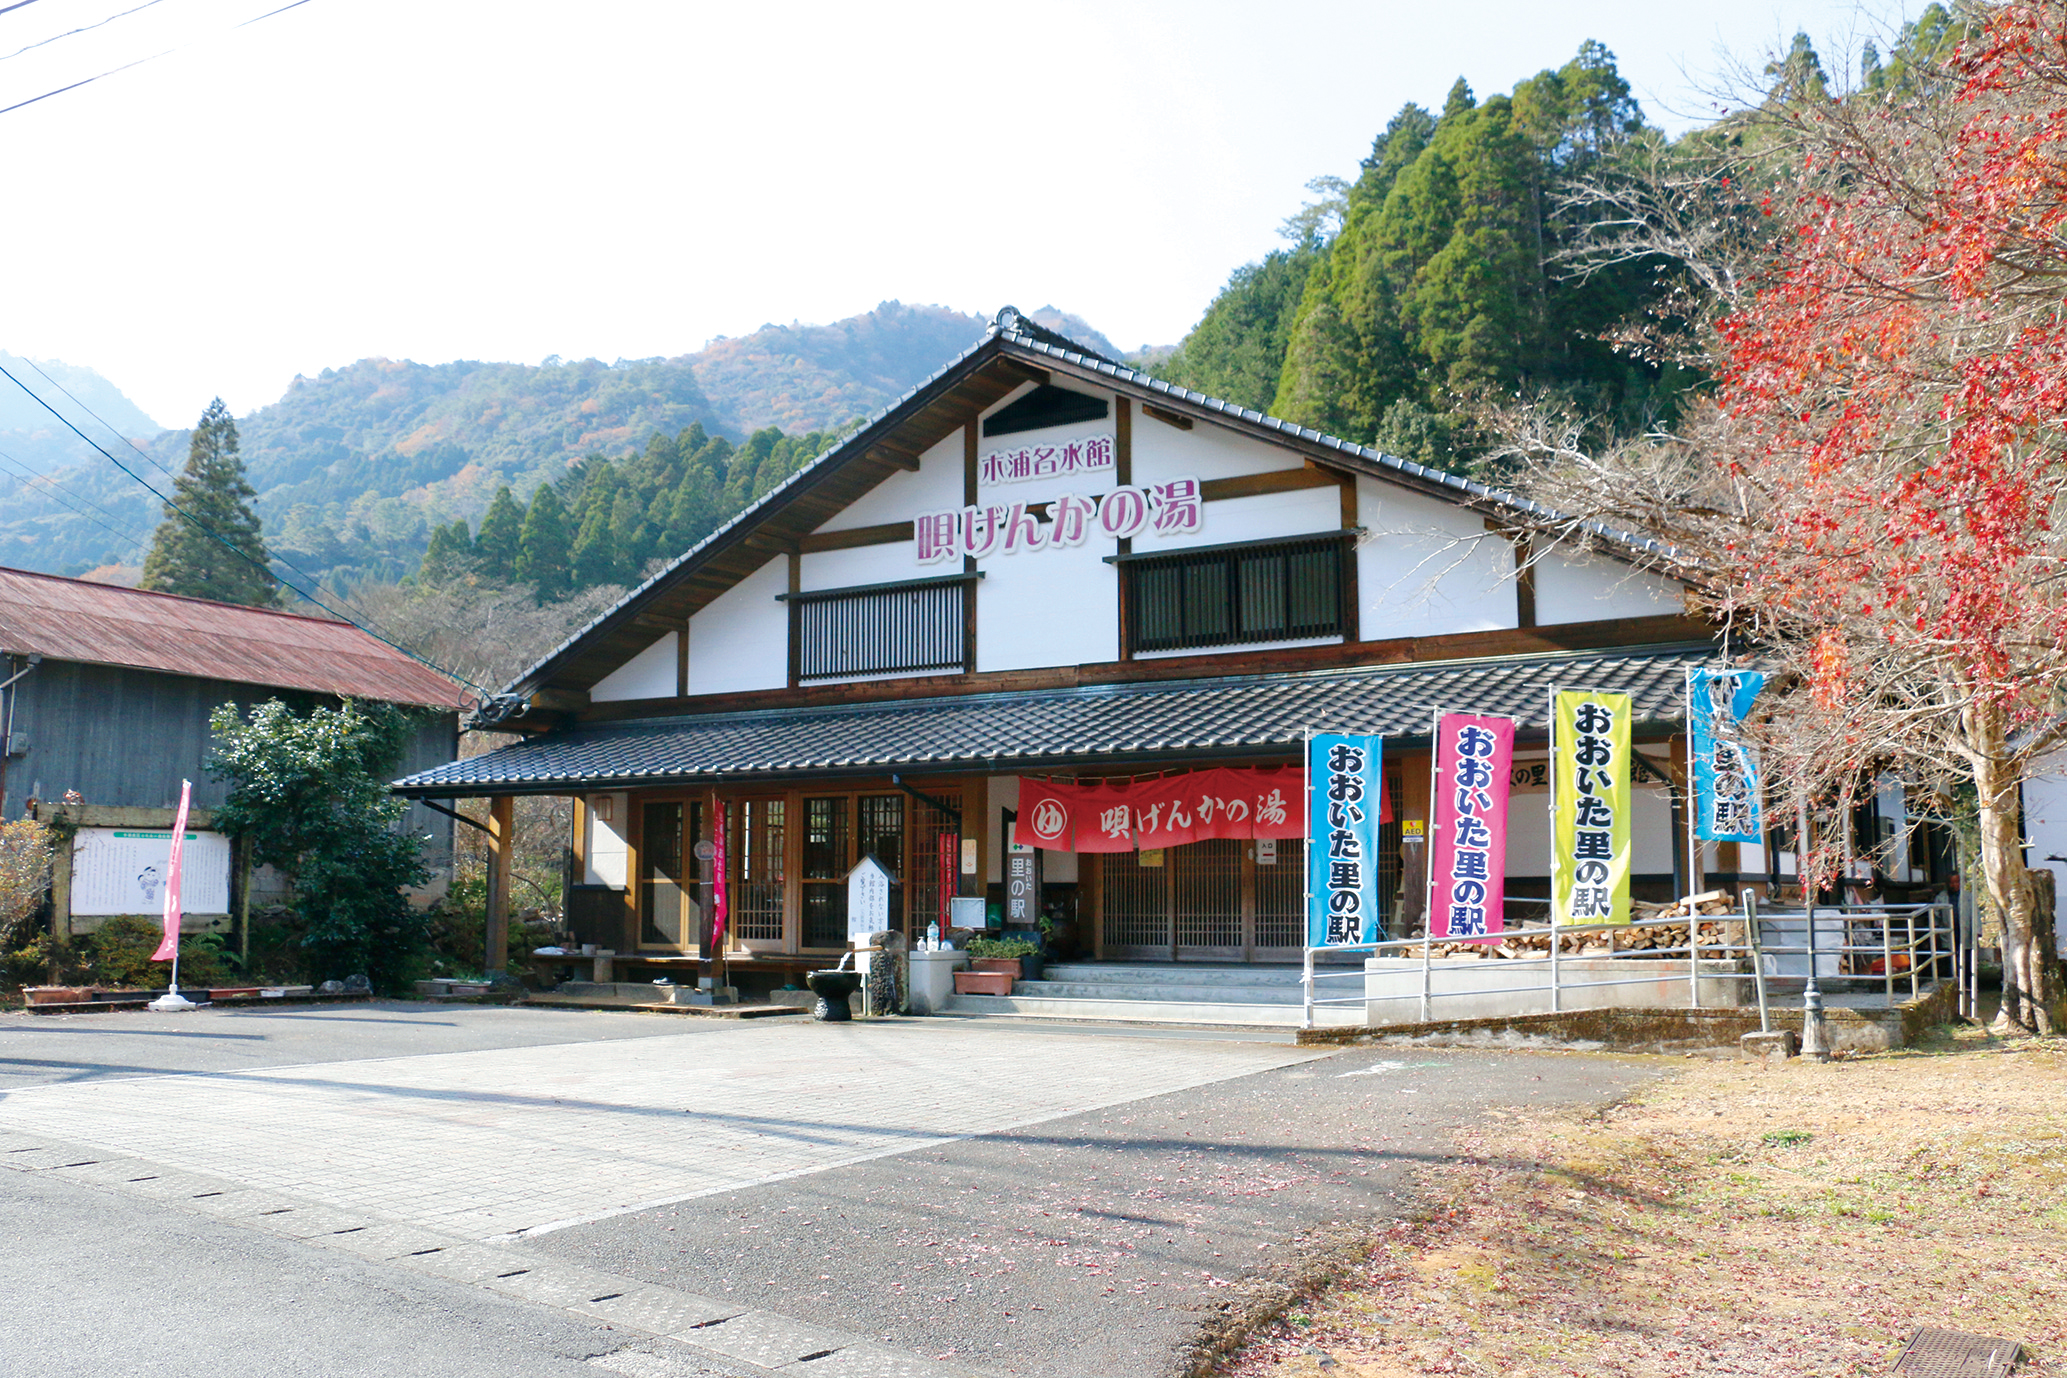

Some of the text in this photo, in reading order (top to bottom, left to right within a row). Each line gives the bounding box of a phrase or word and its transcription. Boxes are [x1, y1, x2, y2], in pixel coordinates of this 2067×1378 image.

[982, 437, 1112, 483] 木浦名水館
[917, 479, 1197, 560] 唄げんかの湯
[1510, 764, 1548, 787] の里
[1034, 802, 1065, 836] ゆ
[1100, 788, 1287, 839] 唄げんかの湯
[1449, 726, 1496, 935] おおいた里の駅
[1574, 703, 1613, 917] おおいた里の駅
[1327, 744, 1364, 944] おおいた里の駅
[1011, 858, 1025, 918] 里の駅
